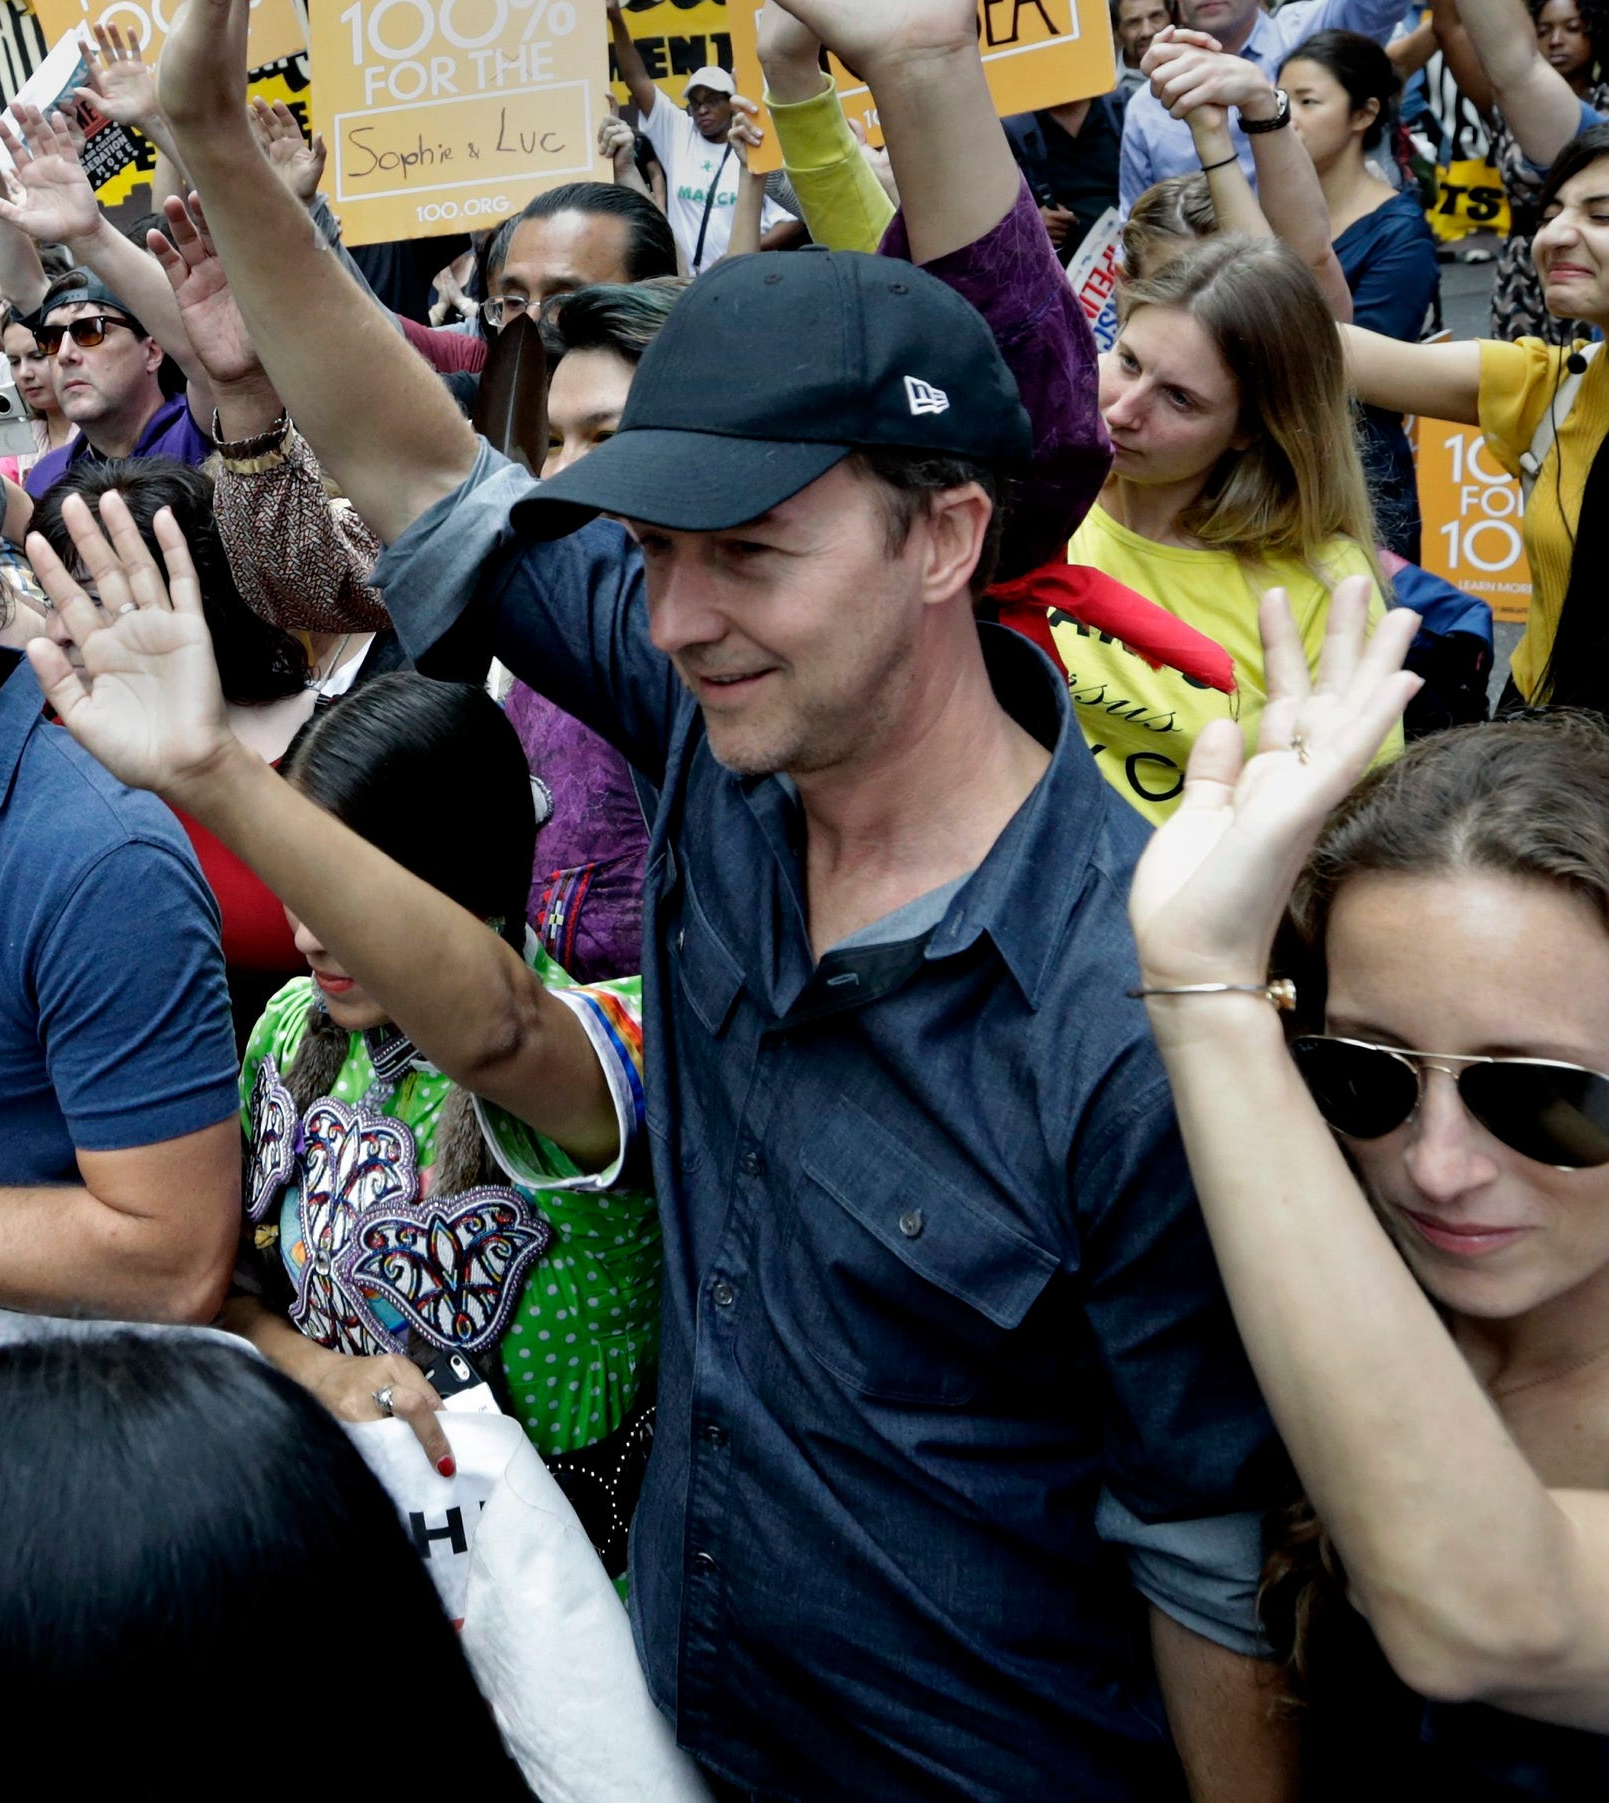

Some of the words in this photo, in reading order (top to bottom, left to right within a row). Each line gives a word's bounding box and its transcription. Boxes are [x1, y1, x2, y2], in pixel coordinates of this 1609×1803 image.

[340, 0, 578, 66] 100%
[364, 56, 458, 105] FOR
[467, 41, 554, 90] THE
[348, 126, 454, 180] Sophie
[467, 141, 480, 160] &
[415, 196, 511, 223] 100.ORG
